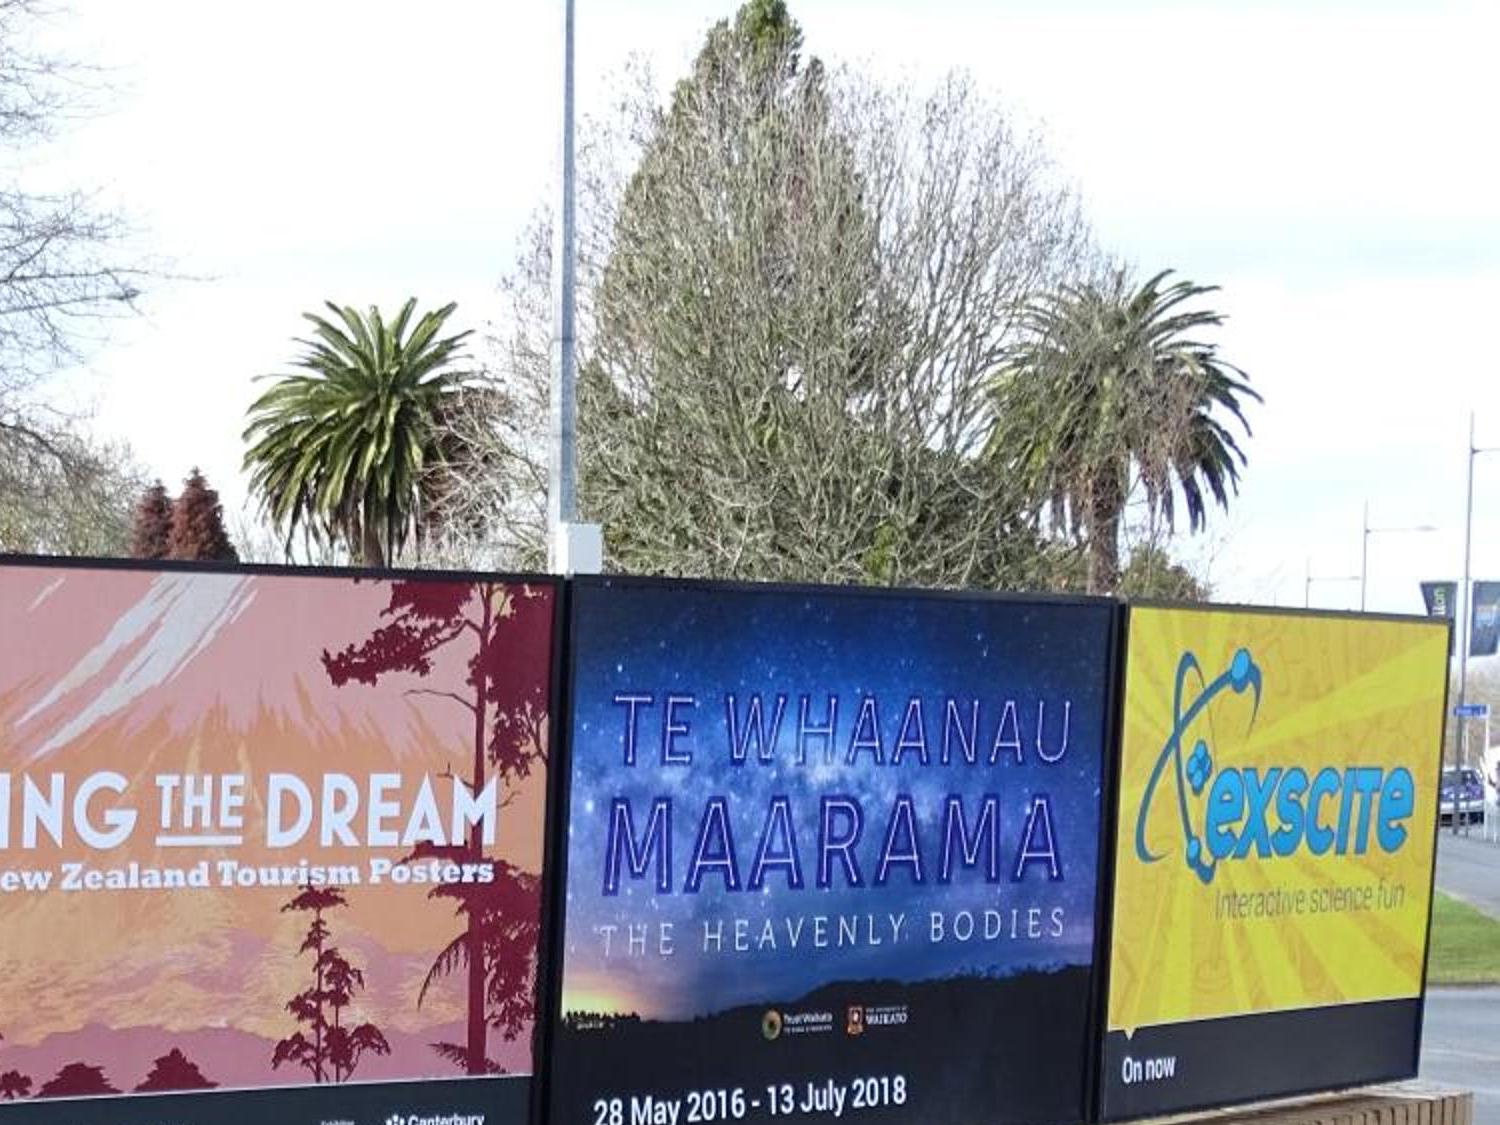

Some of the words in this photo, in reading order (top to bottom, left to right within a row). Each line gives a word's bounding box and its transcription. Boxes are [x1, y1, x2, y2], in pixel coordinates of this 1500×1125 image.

[615, 694, 694, 766] TE
[726, 694, 1072, 766] WHAANAU
[156, 775, 244, 829] THE
[266, 773, 495, 849] DREAM
[602, 797, 1065, 896] MAARAMA
[61, 861, 208, 891] Zealand
[217, 859, 360, 886] Tourism
[370, 857, 494, 884] Posters
[1215, 886, 1305, 920] Interactive
[1309, 885, 1372, 912] science
[1376, 880, 1405, 910] fun
[599, 923, 674, 957] THE
[703, 914, 906, 953] HEAVENLY
[930, 906, 1066, 942] BODIES
[1122, 1057, 1143, 1084] On
[1145, 1057, 1176, 1080] now
[687, 1089, 745, 1122] 2016
[767, 1085, 794, 1115] 13
[800, 1079, 847, 1116] July
[852, 1075, 907, 1107] 2018
